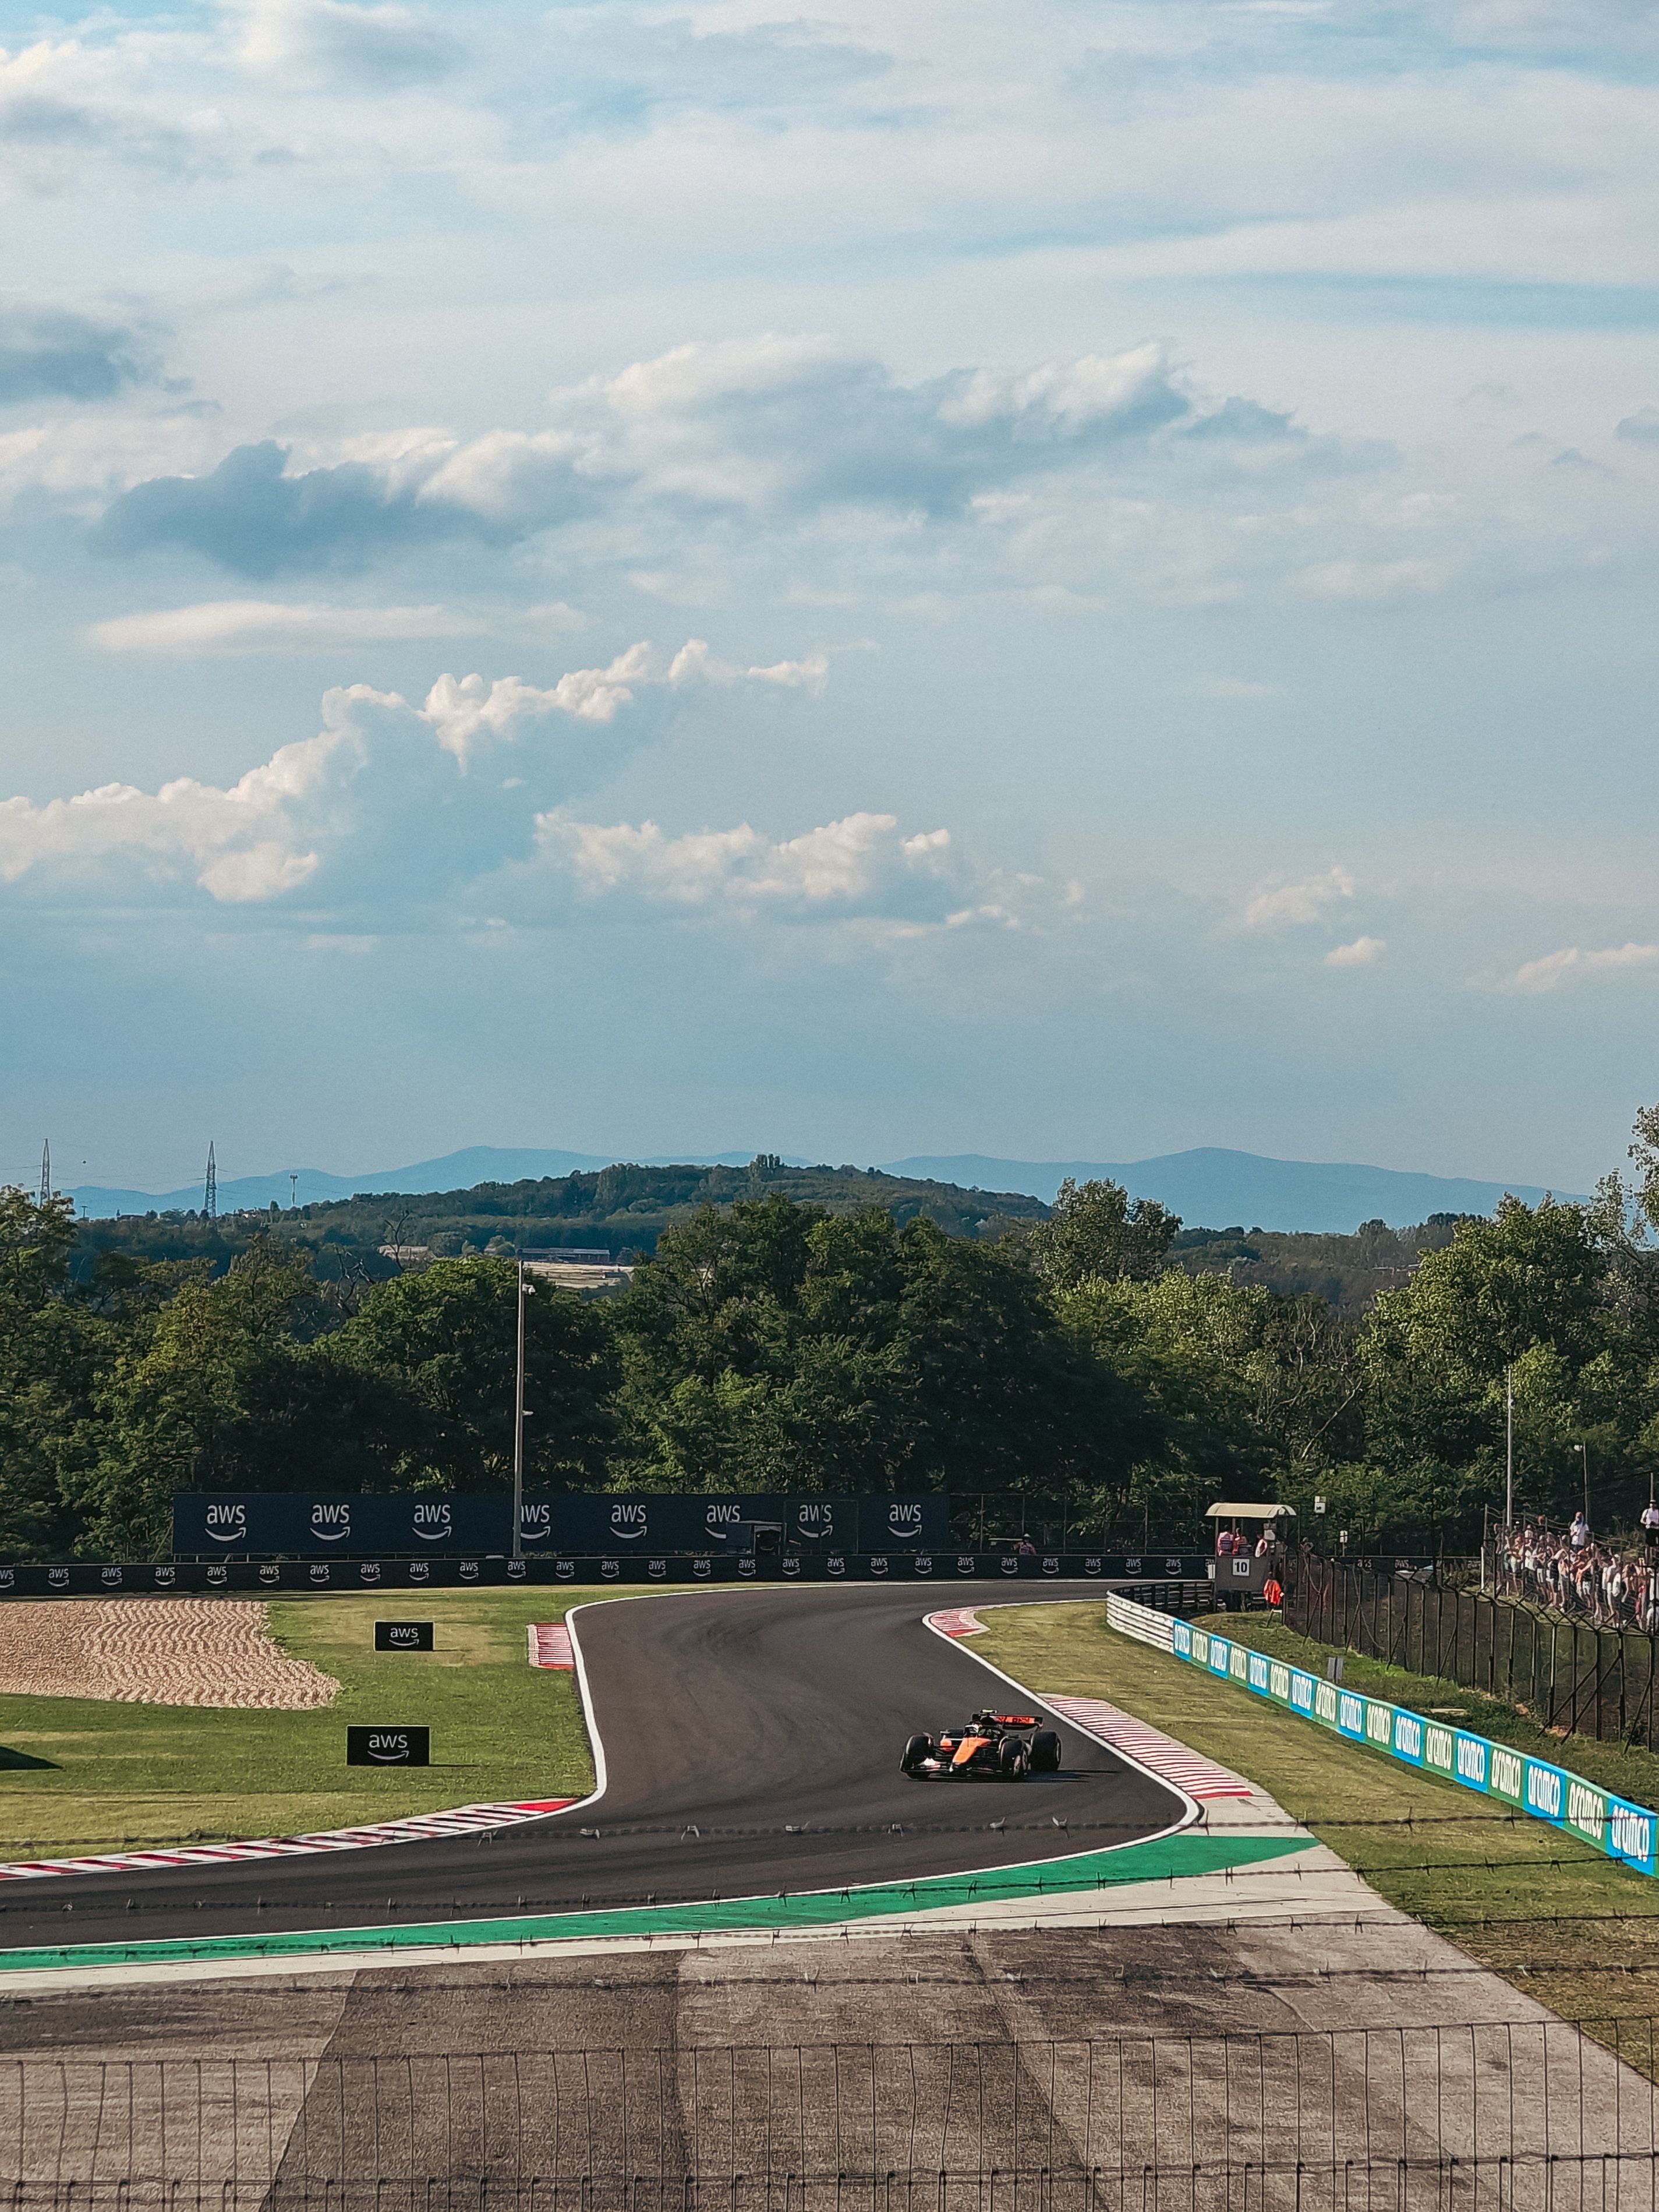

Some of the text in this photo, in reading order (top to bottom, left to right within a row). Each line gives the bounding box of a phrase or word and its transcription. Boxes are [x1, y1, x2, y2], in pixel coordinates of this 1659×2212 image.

[207, 1506, 245, 1524] aws
[312, 1505, 349, 1523] aws
[415, 1504, 450, 1522] aws
[612, 1505, 646, 1522] aws
[707, 1506, 740, 1522] aws
[890, 1504, 921, 1521] aws
[459, 1561, 478, 1571] aws
[508, 1561, 526, 1571] aws
[556, 1561, 575, 1571] aws
[602, 1560, 619, 1571] aws
[649, 1560, 666, 1570] aws
[693, 1559, 711, 1569] aws
[738, 1559, 756, 1568] aws
[782, 1558, 800, 1568] aws
[827, 1557, 844, 1567] aws
[871, 1557, 887, 1567] aws
[915, 1557, 932, 1566] aws
[957, 1556, 974, 1566] aws
[1001, 1557, 1017, 1567] aws
[1042, 1557, 1059, 1567] aws
[1085, 1558, 1101, 1567] aws
[1126, 1558, 1141, 1567] aws
[1165, 1559, 1182, 1568] aws
[155, 1567, 175, 1577] aws
[207, 1566, 227, 1576] aws
[259, 1565, 280, 1575] aws
[310, 1564, 329, 1575] aws
[360, 1563, 380, 1574] aws
[409, 1563, 429, 1573] aws
[1236, 1561, 1247, 1573] 10
[0, 1569, 14, 1580] ws
[48, 1568, 69, 1578] aws
[101, 1567, 122, 1578] aws
[391, 1628, 418, 1638] aws
[369, 1735, 407, 1748] aws
[1491, 1749, 1520, 1798] aramco
[1528, 1765, 1560, 1817] aramco
[1569, 1782, 1603, 1840] aramco
[1612, 1804, 1649, 1862] aramco
